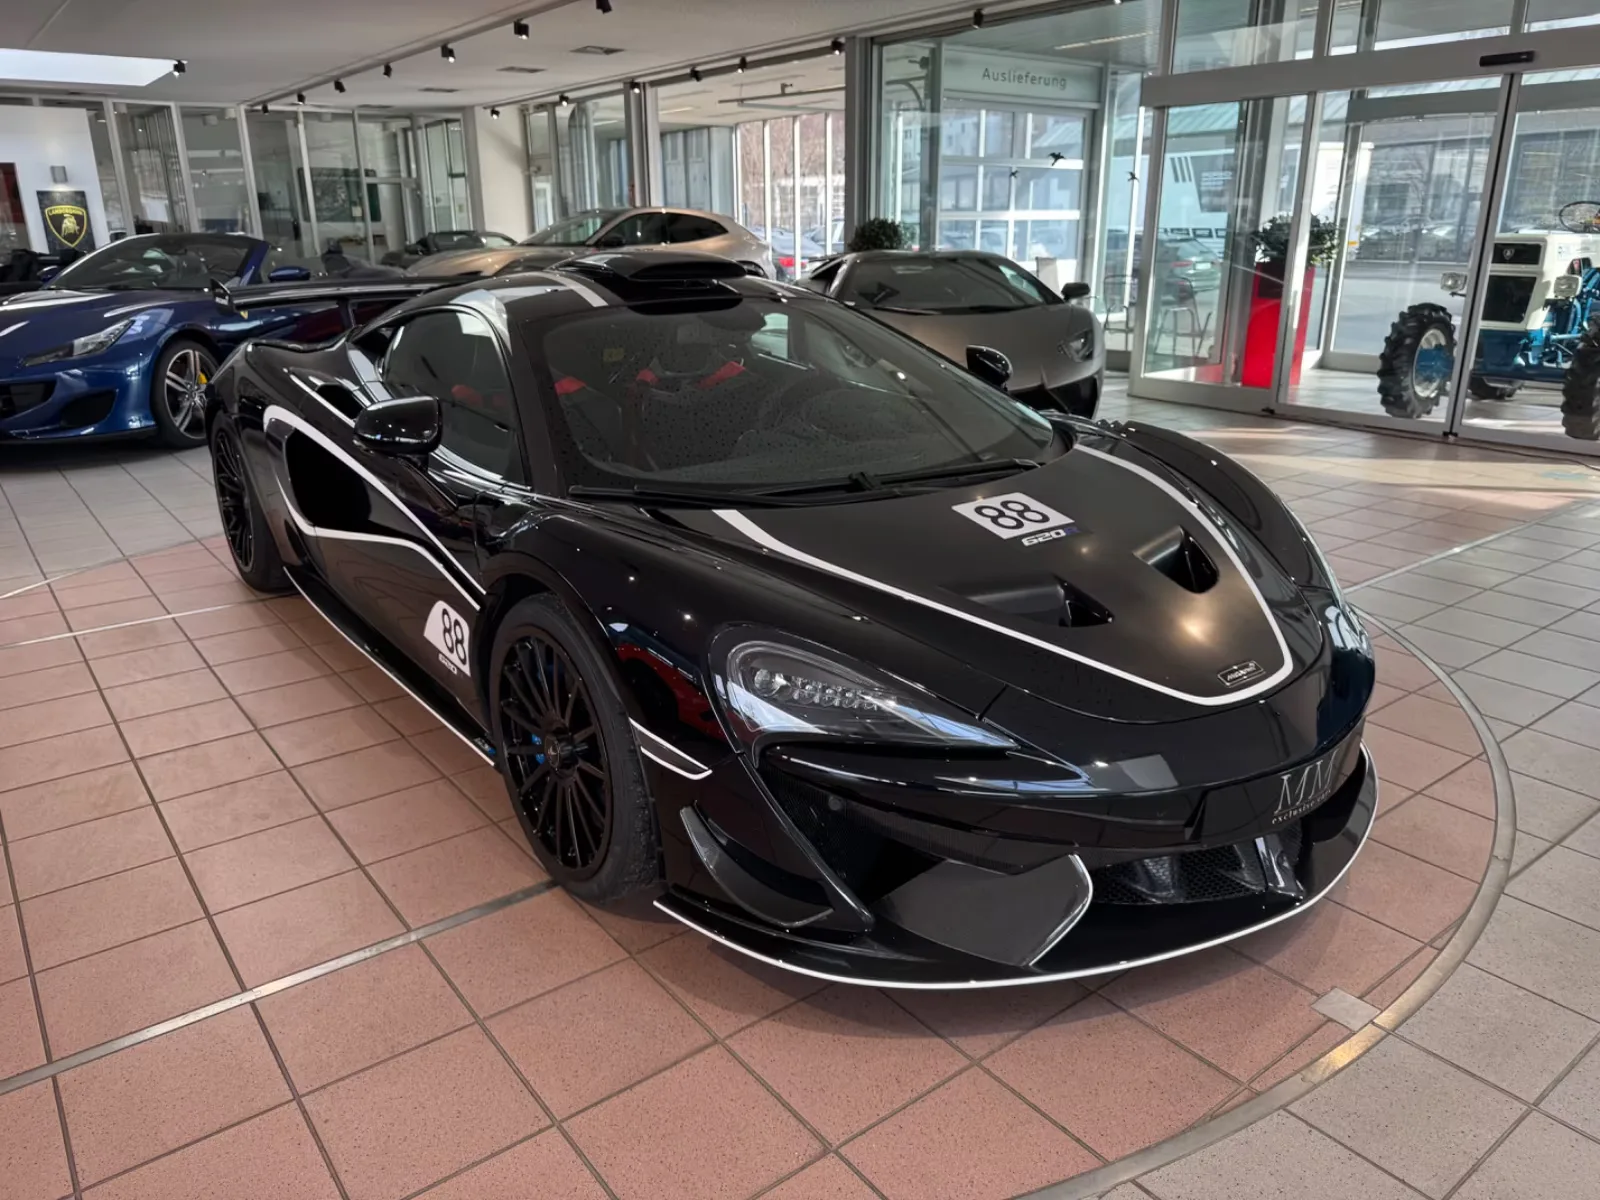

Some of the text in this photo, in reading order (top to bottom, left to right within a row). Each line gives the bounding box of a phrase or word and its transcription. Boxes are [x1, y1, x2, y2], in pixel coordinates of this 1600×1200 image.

[982, 67, 1067, 91] Auslieferung
[974, 500, 1050, 530] 88
[442, 608, 467, 666] 88
[1273, 748, 1340, 815] MM
